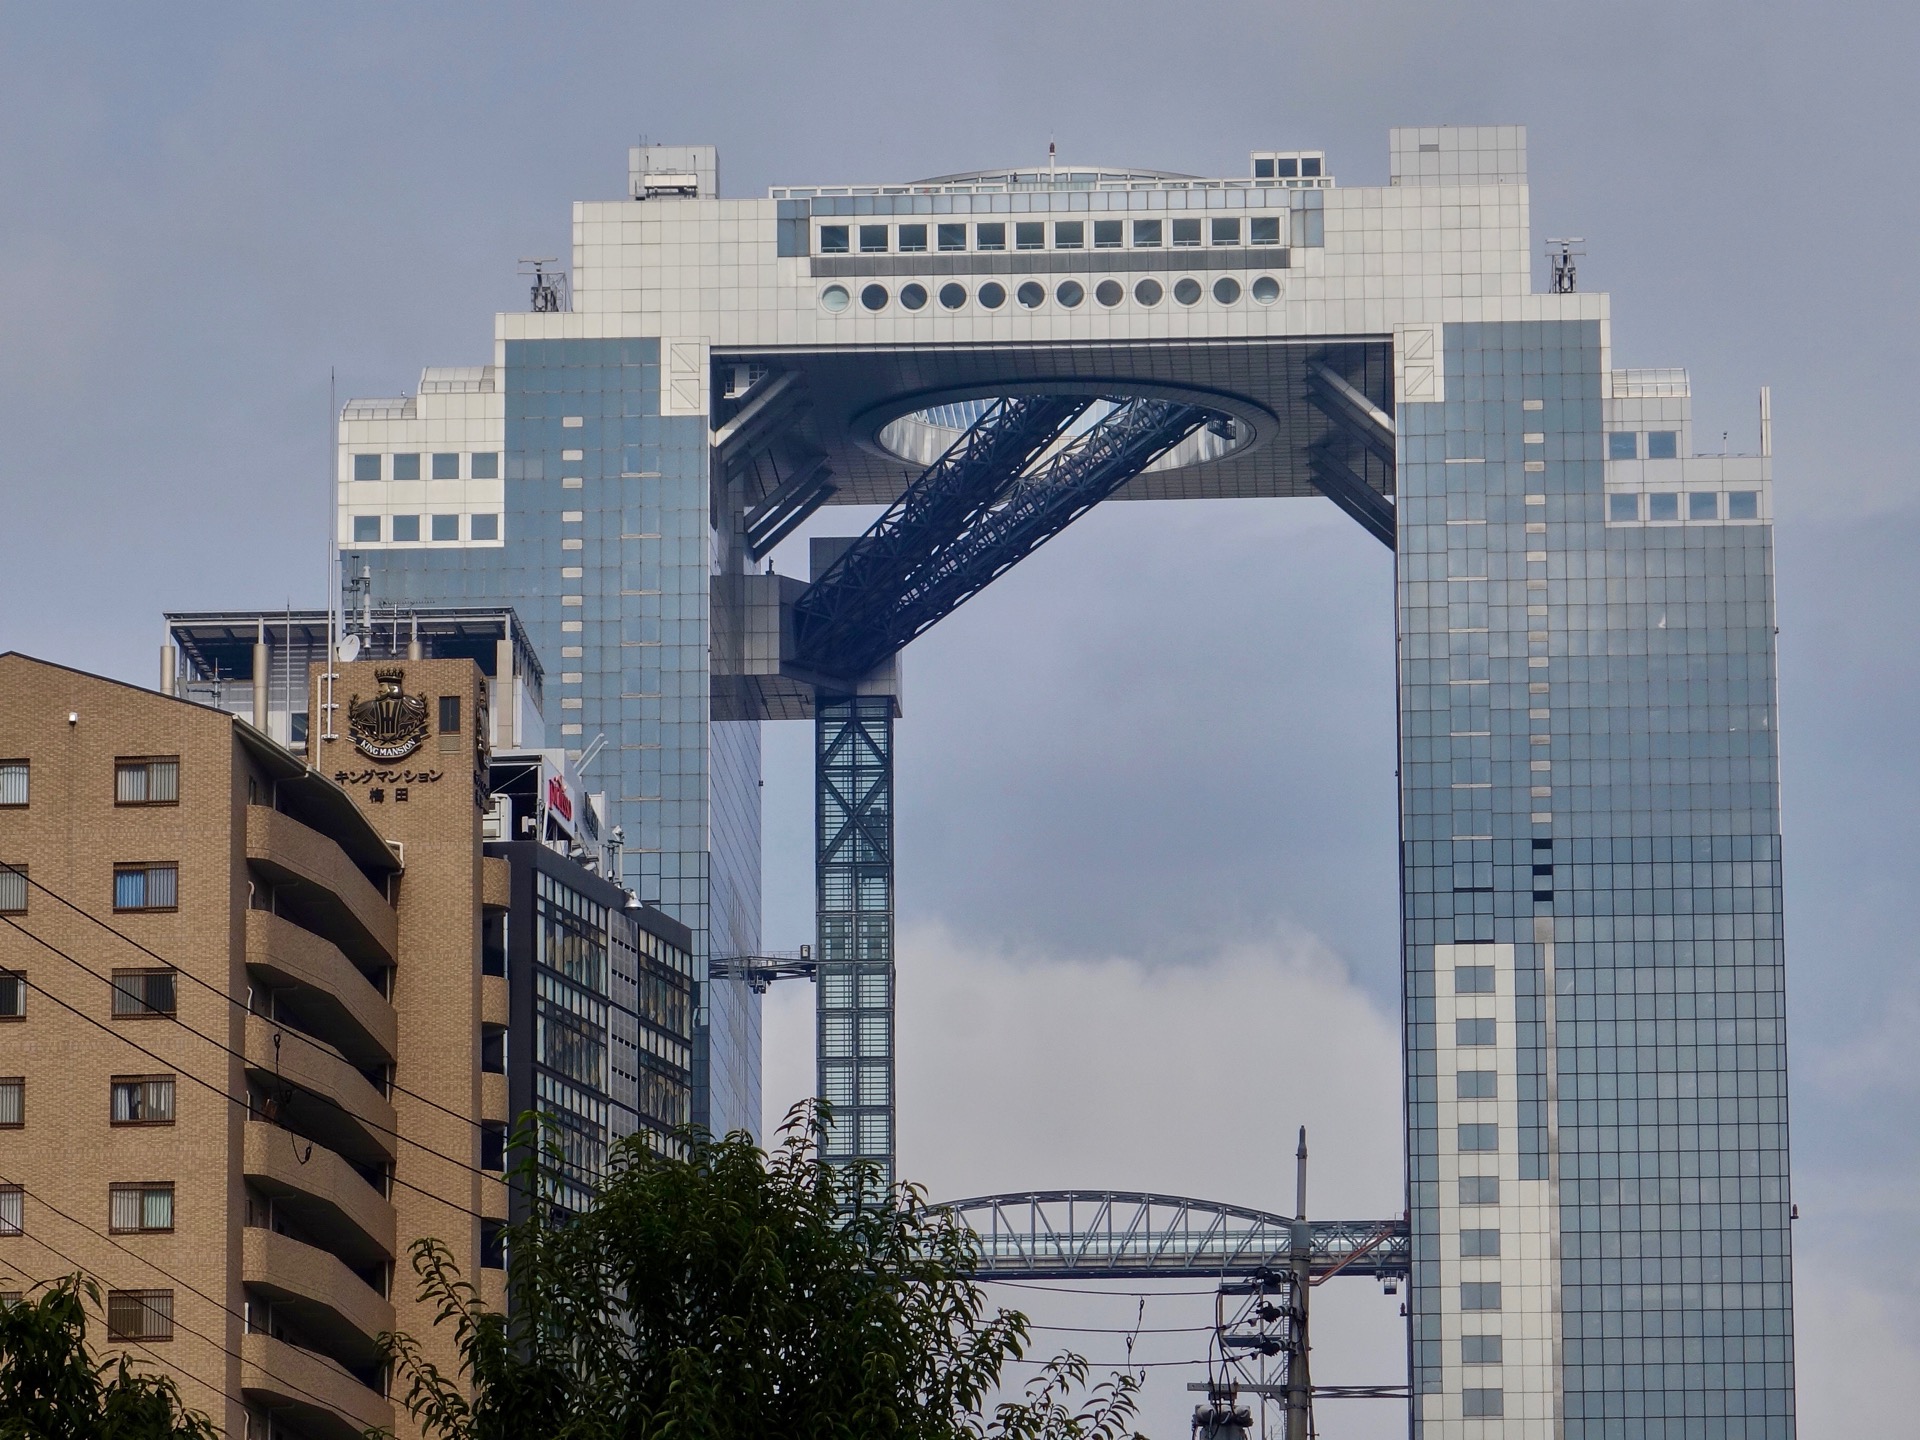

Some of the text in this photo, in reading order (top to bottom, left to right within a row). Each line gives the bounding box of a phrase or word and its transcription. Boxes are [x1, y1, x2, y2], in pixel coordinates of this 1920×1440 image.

[360, 738, 416, 756] KING MANSION
[335, 769, 443, 785] キングマンション
